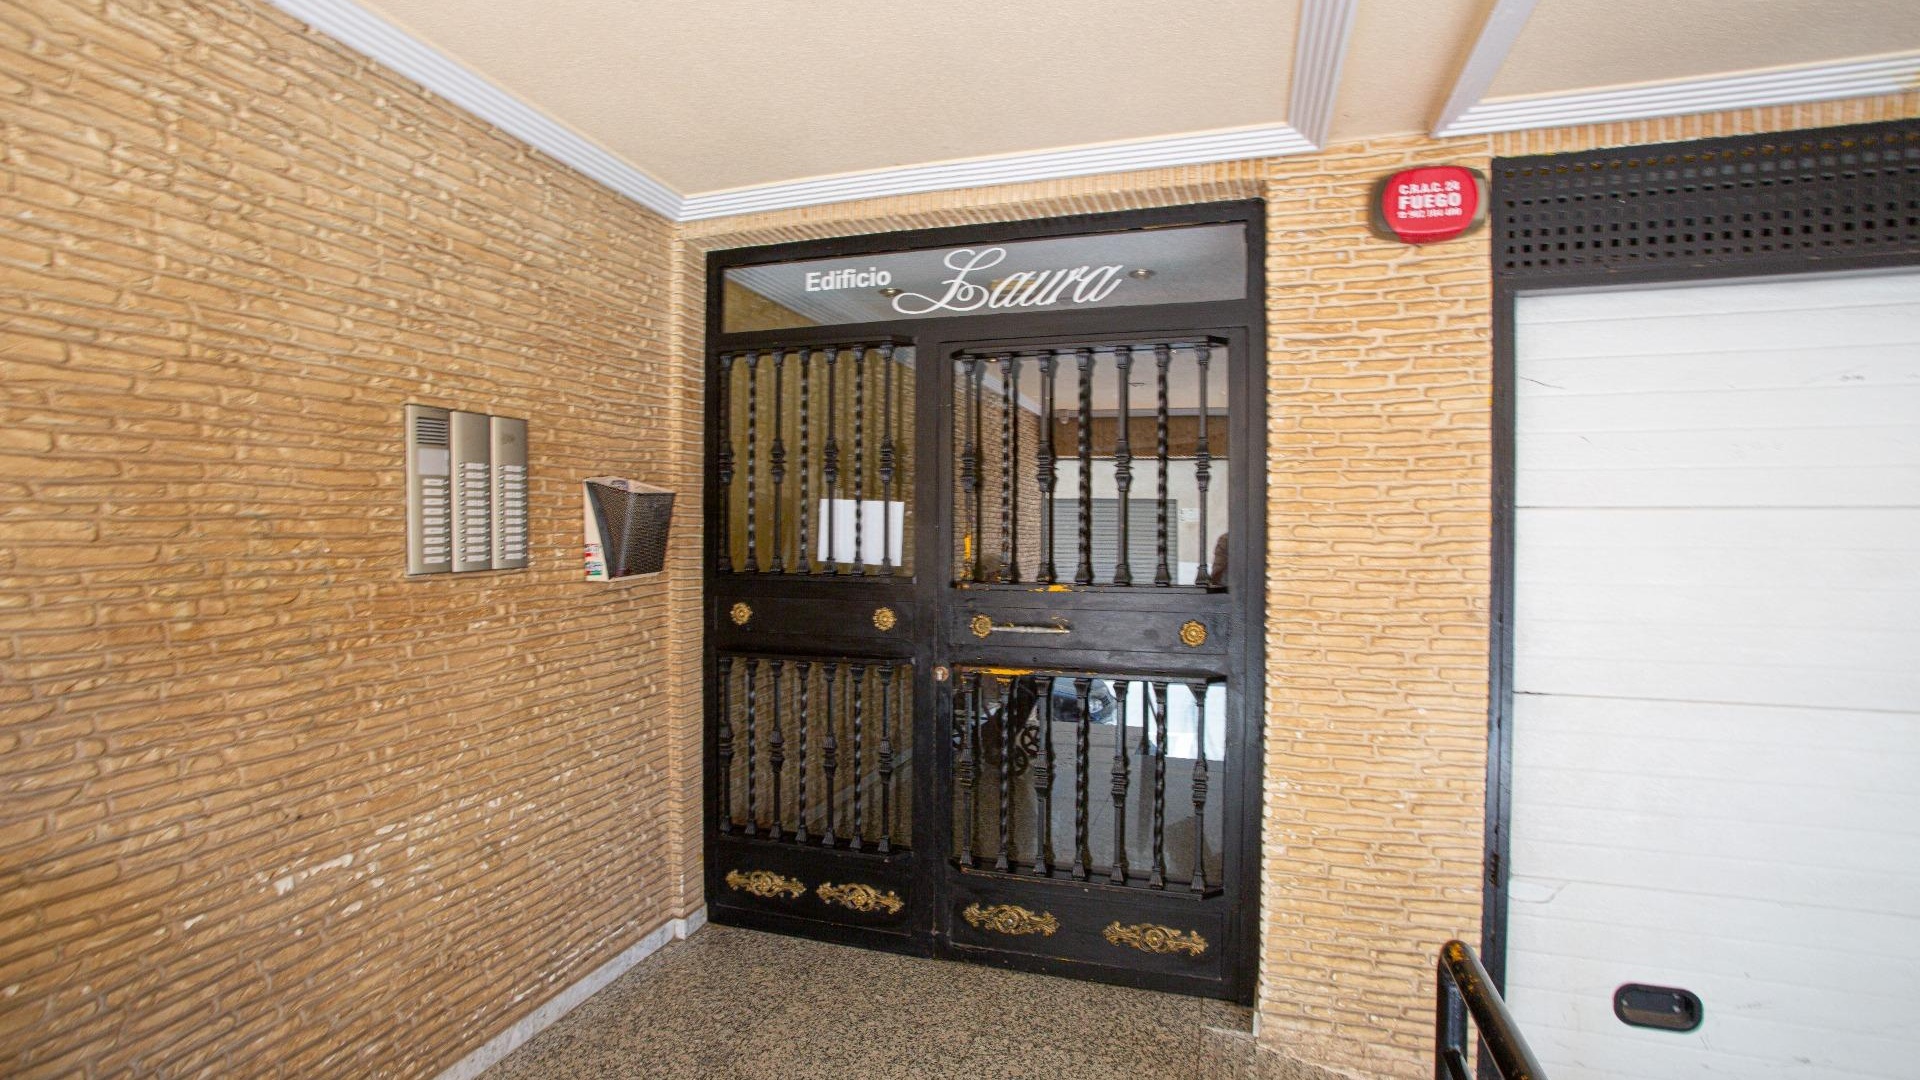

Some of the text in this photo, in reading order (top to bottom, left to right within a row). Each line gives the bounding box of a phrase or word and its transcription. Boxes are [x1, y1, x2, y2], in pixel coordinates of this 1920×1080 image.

[1398, 192, 1462, 210] FUEGO
[805, 247, 1124, 315] Edificio Laura
